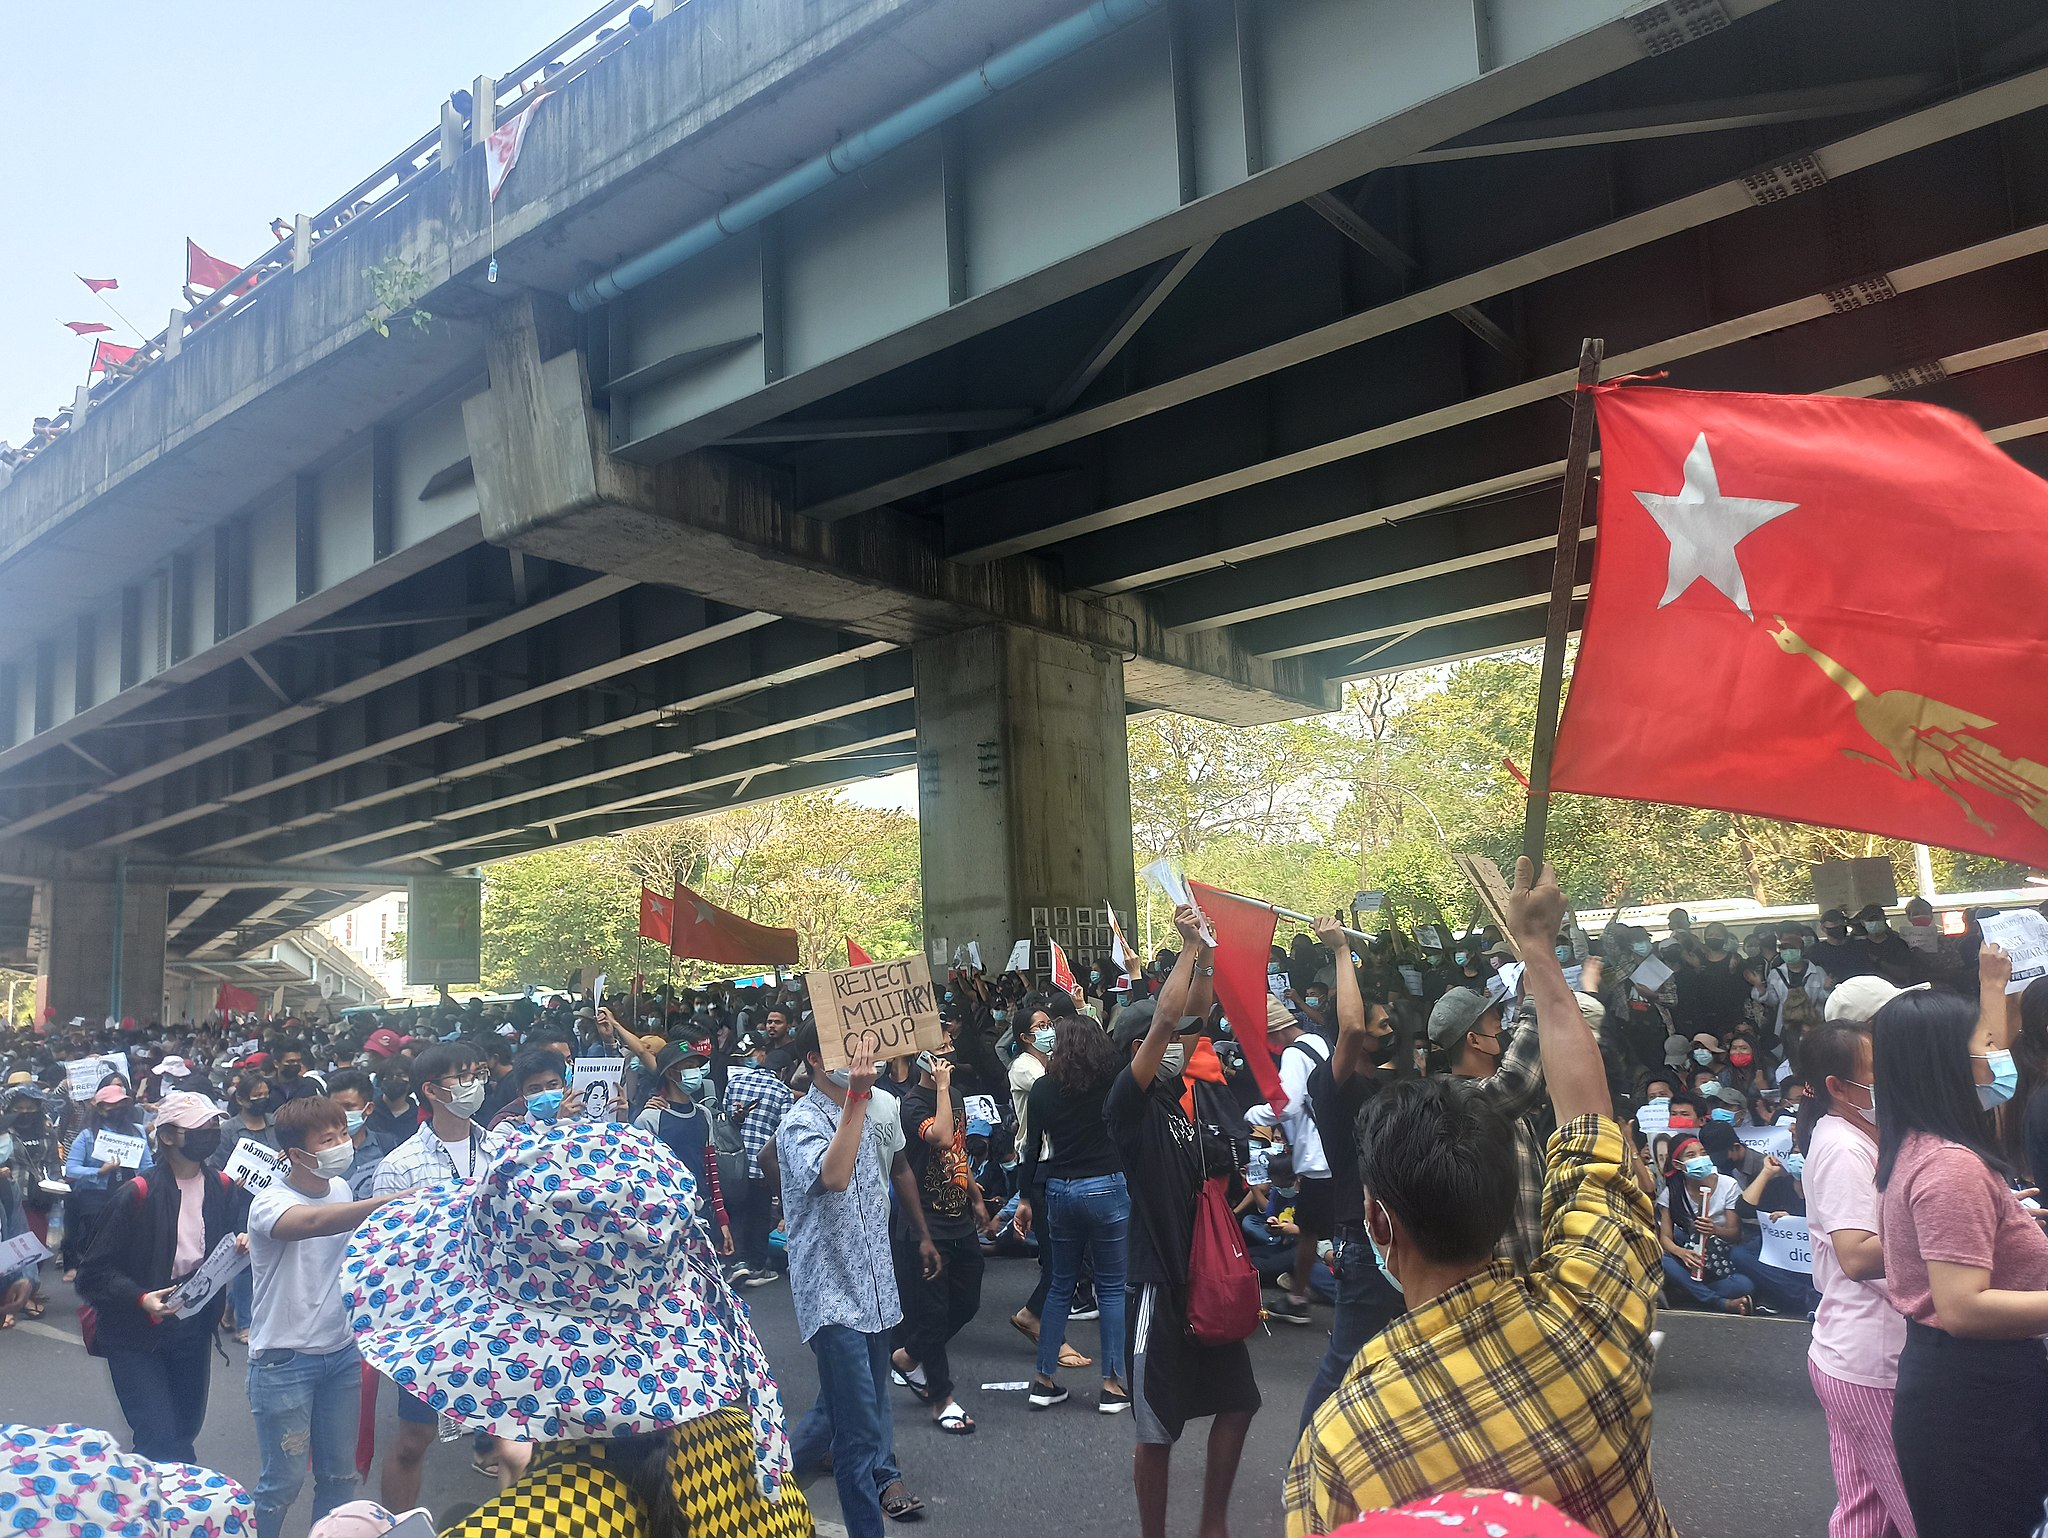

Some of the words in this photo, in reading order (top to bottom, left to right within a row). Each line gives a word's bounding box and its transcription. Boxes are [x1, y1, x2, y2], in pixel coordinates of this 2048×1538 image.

[833, 960, 911, 998] REJECT
[842, 981, 934, 1029] MILITARY
[844, 1016, 915, 1058] COUP
[577, 1065, 600, 1073] FREEDOM
[1789, 1247, 1812, 1263] dic
